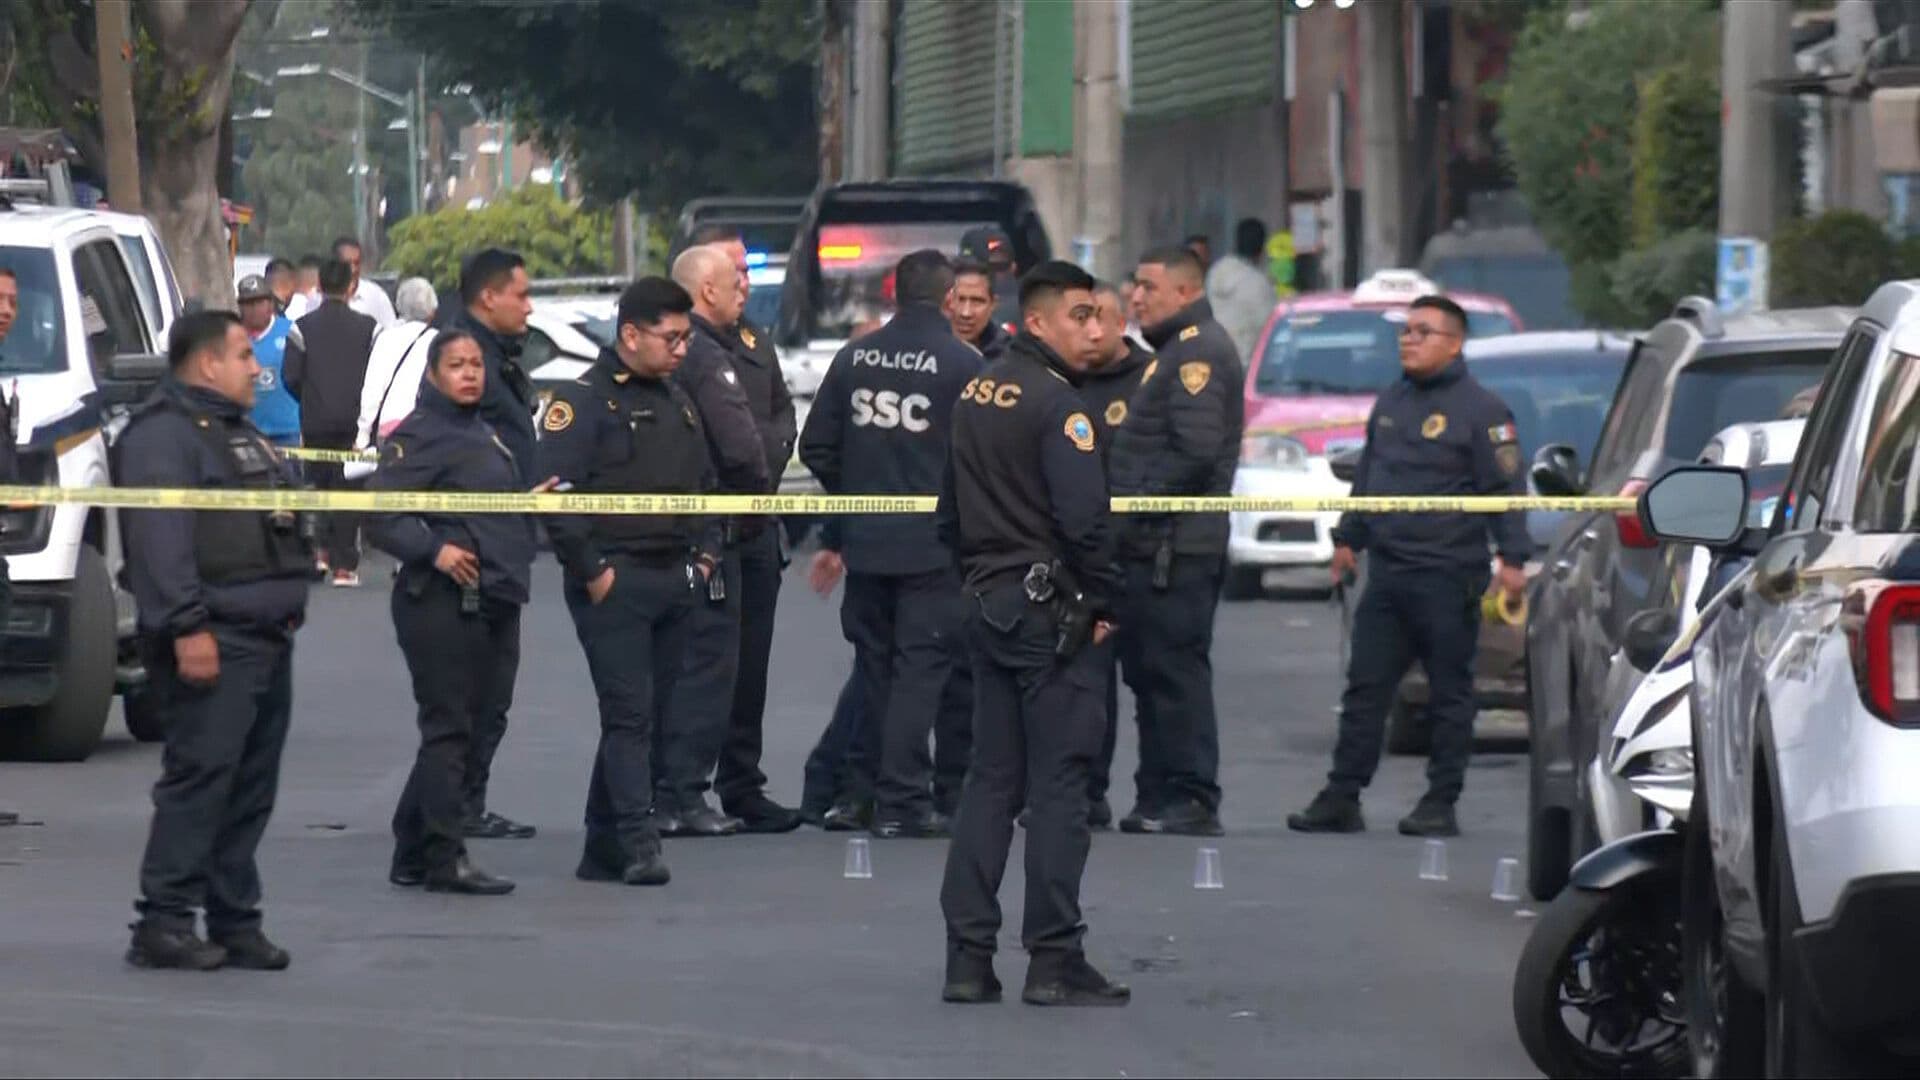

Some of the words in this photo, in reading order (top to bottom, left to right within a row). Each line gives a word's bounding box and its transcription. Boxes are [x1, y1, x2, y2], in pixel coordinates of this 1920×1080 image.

[852, 349, 938, 375] POLICÍA
[960, 377, 1023, 408] SSC
[850, 387, 932, 433] SSC
